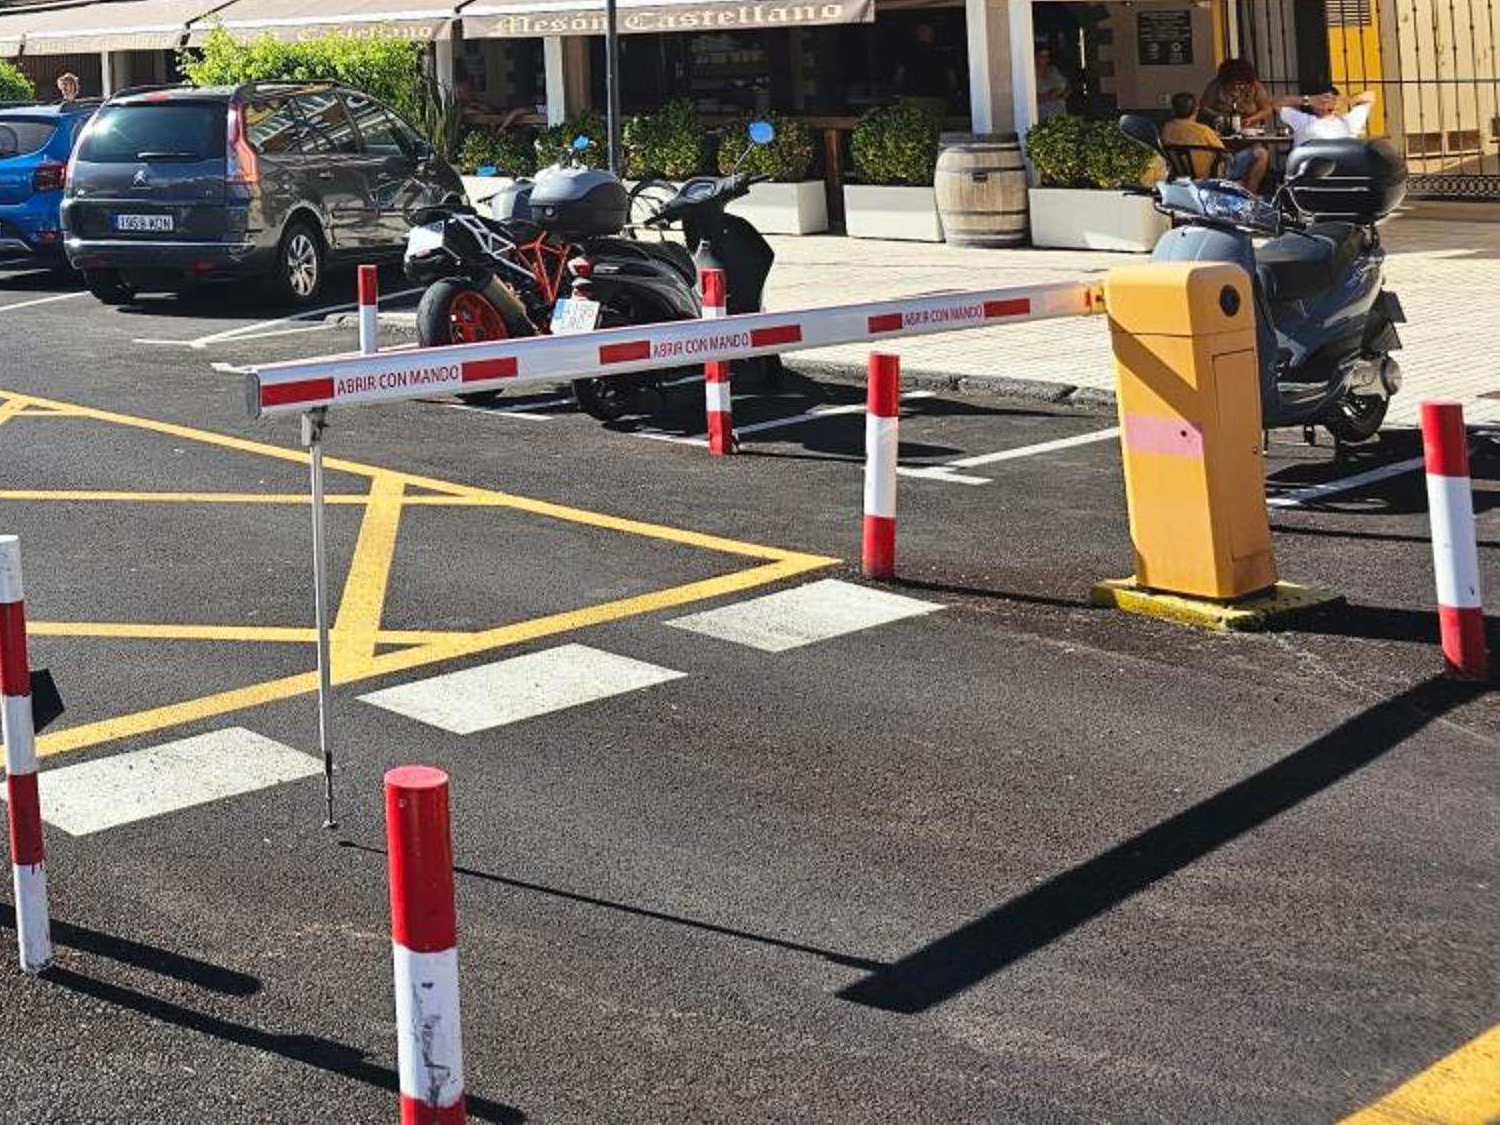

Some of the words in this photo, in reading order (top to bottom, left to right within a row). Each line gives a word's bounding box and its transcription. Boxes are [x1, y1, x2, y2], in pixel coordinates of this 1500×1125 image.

[625, 4, 843, 31] Castellano
[902, 310, 930, 327] ABRIR
[931, 308, 950, 323] CON
[952, 304, 982, 322] MANDO
[653, 339, 683, 358] ABRIR
[685, 336, 709, 354] CON
[710, 331, 749, 352] MANDO
[337, 375, 377, 395] ABRIR
[379, 372, 408, 390] CON
[410, 365, 460, 386] MANDO
